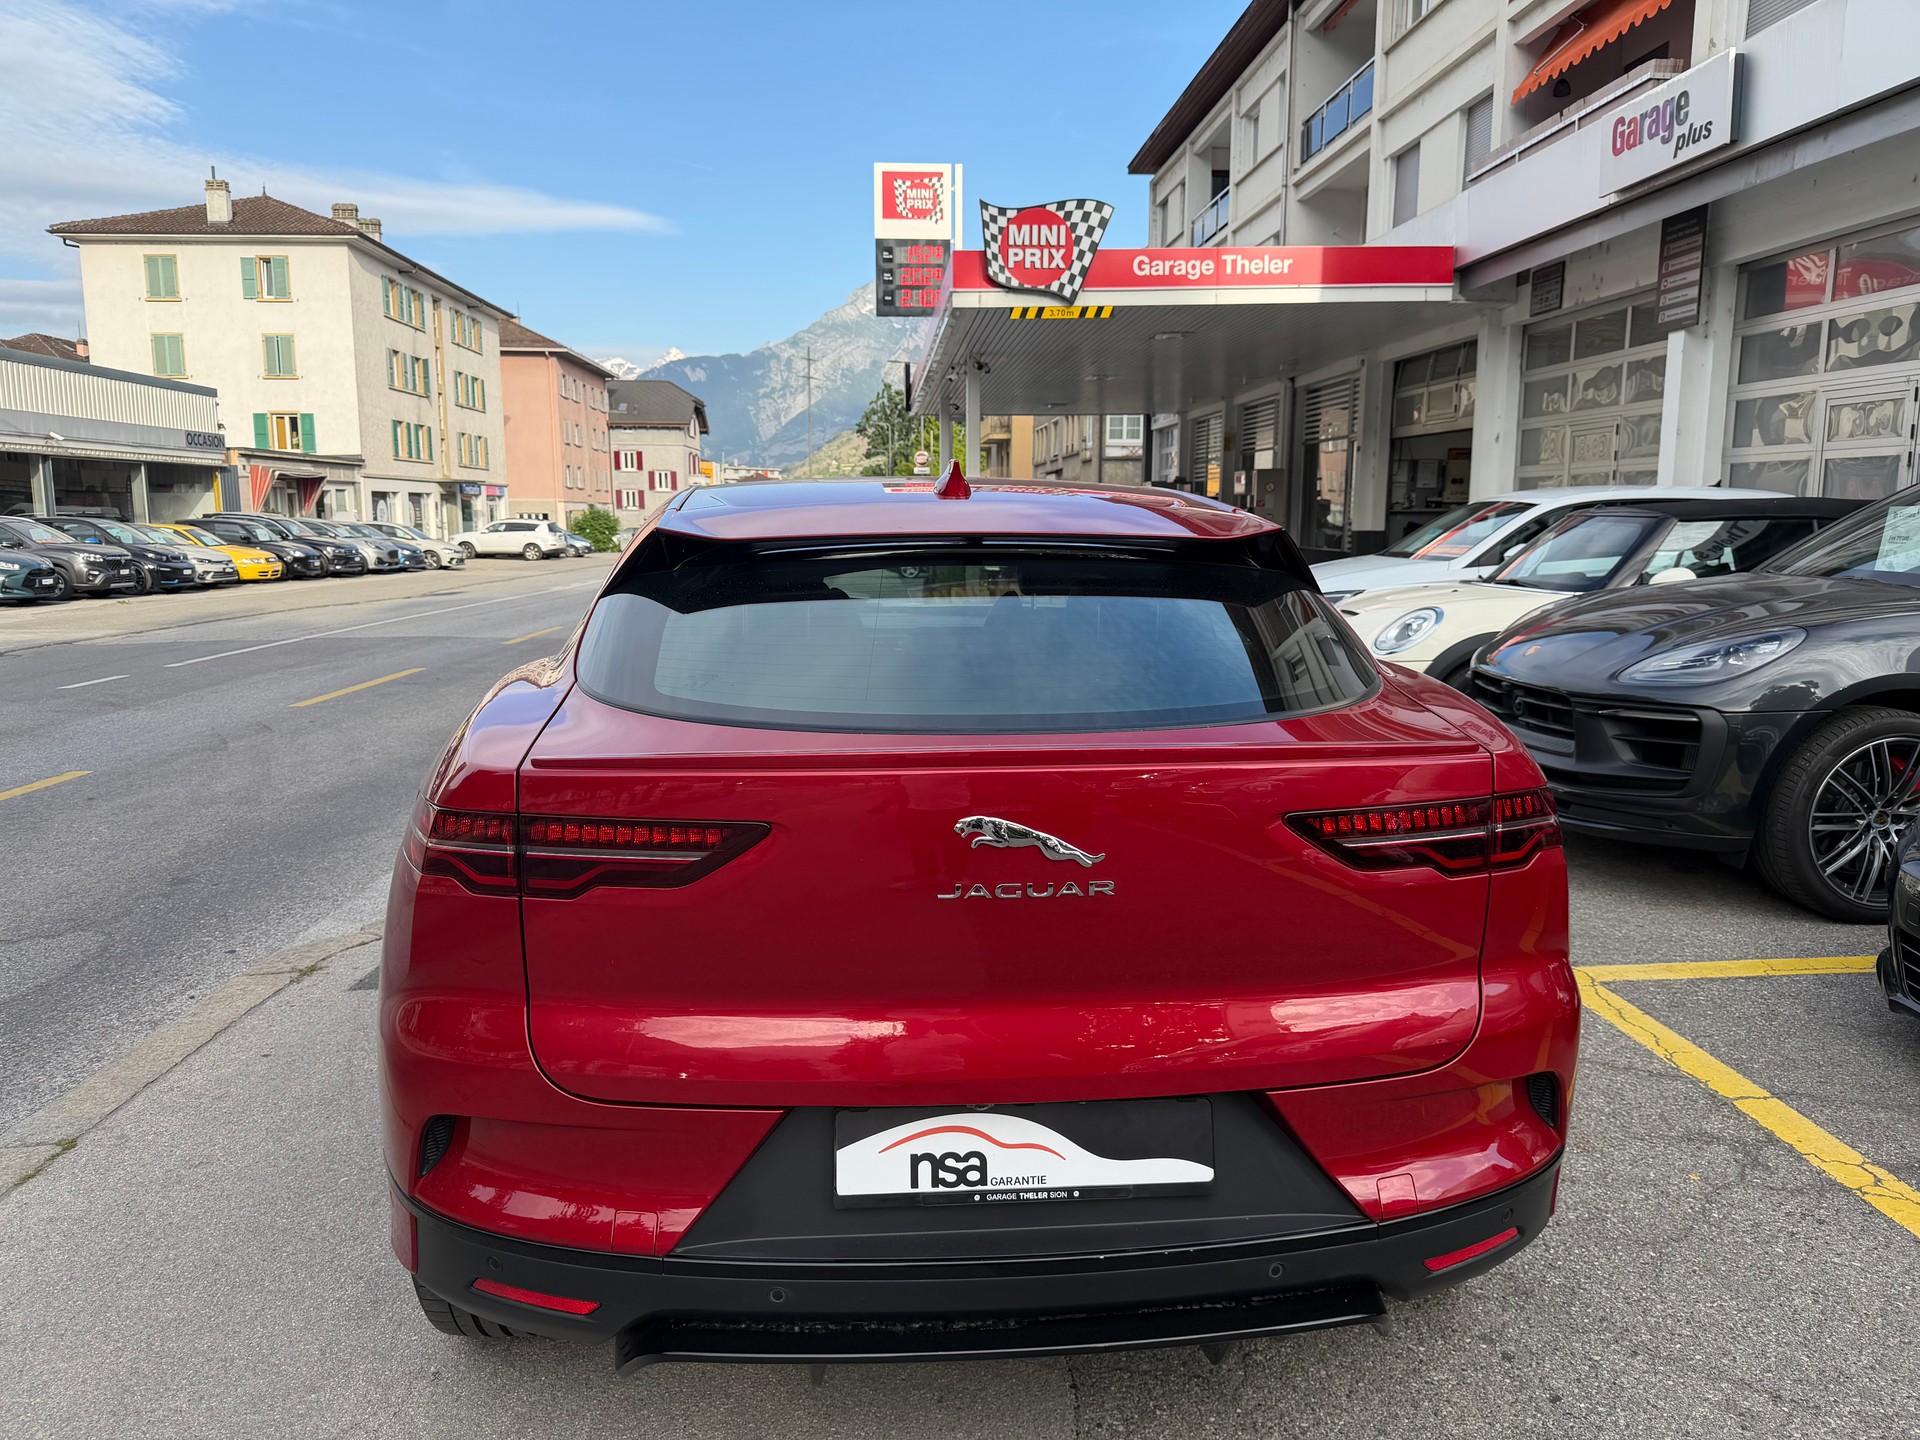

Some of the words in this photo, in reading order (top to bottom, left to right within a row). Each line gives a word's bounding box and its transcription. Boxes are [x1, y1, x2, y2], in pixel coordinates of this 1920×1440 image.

[1612, 90, 1690, 157] Garage
[1673, 121, 1713, 159] plus
[906, 188, 933, 199] MINI
[907, 199, 934, 210] PRIX
[1008, 224, 1066, 246] MINI
[1008, 248, 1066, 269] PRIX
[1132, 255, 1215, 280] Garage
[1221, 254, 1293, 275] Theler
[186, 432, 225, 448] OCCASION
[937, 880, 1115, 900] JAGUAR
[910, 1150, 988, 1189] nsa
[990, 1175, 1047, 1187] GARANTIE
[986, 1192, 1017, 1201] GARAGE
[1019, 1191, 1048, 1200] THELER
[1049, 1191, 1068, 1199] SION
